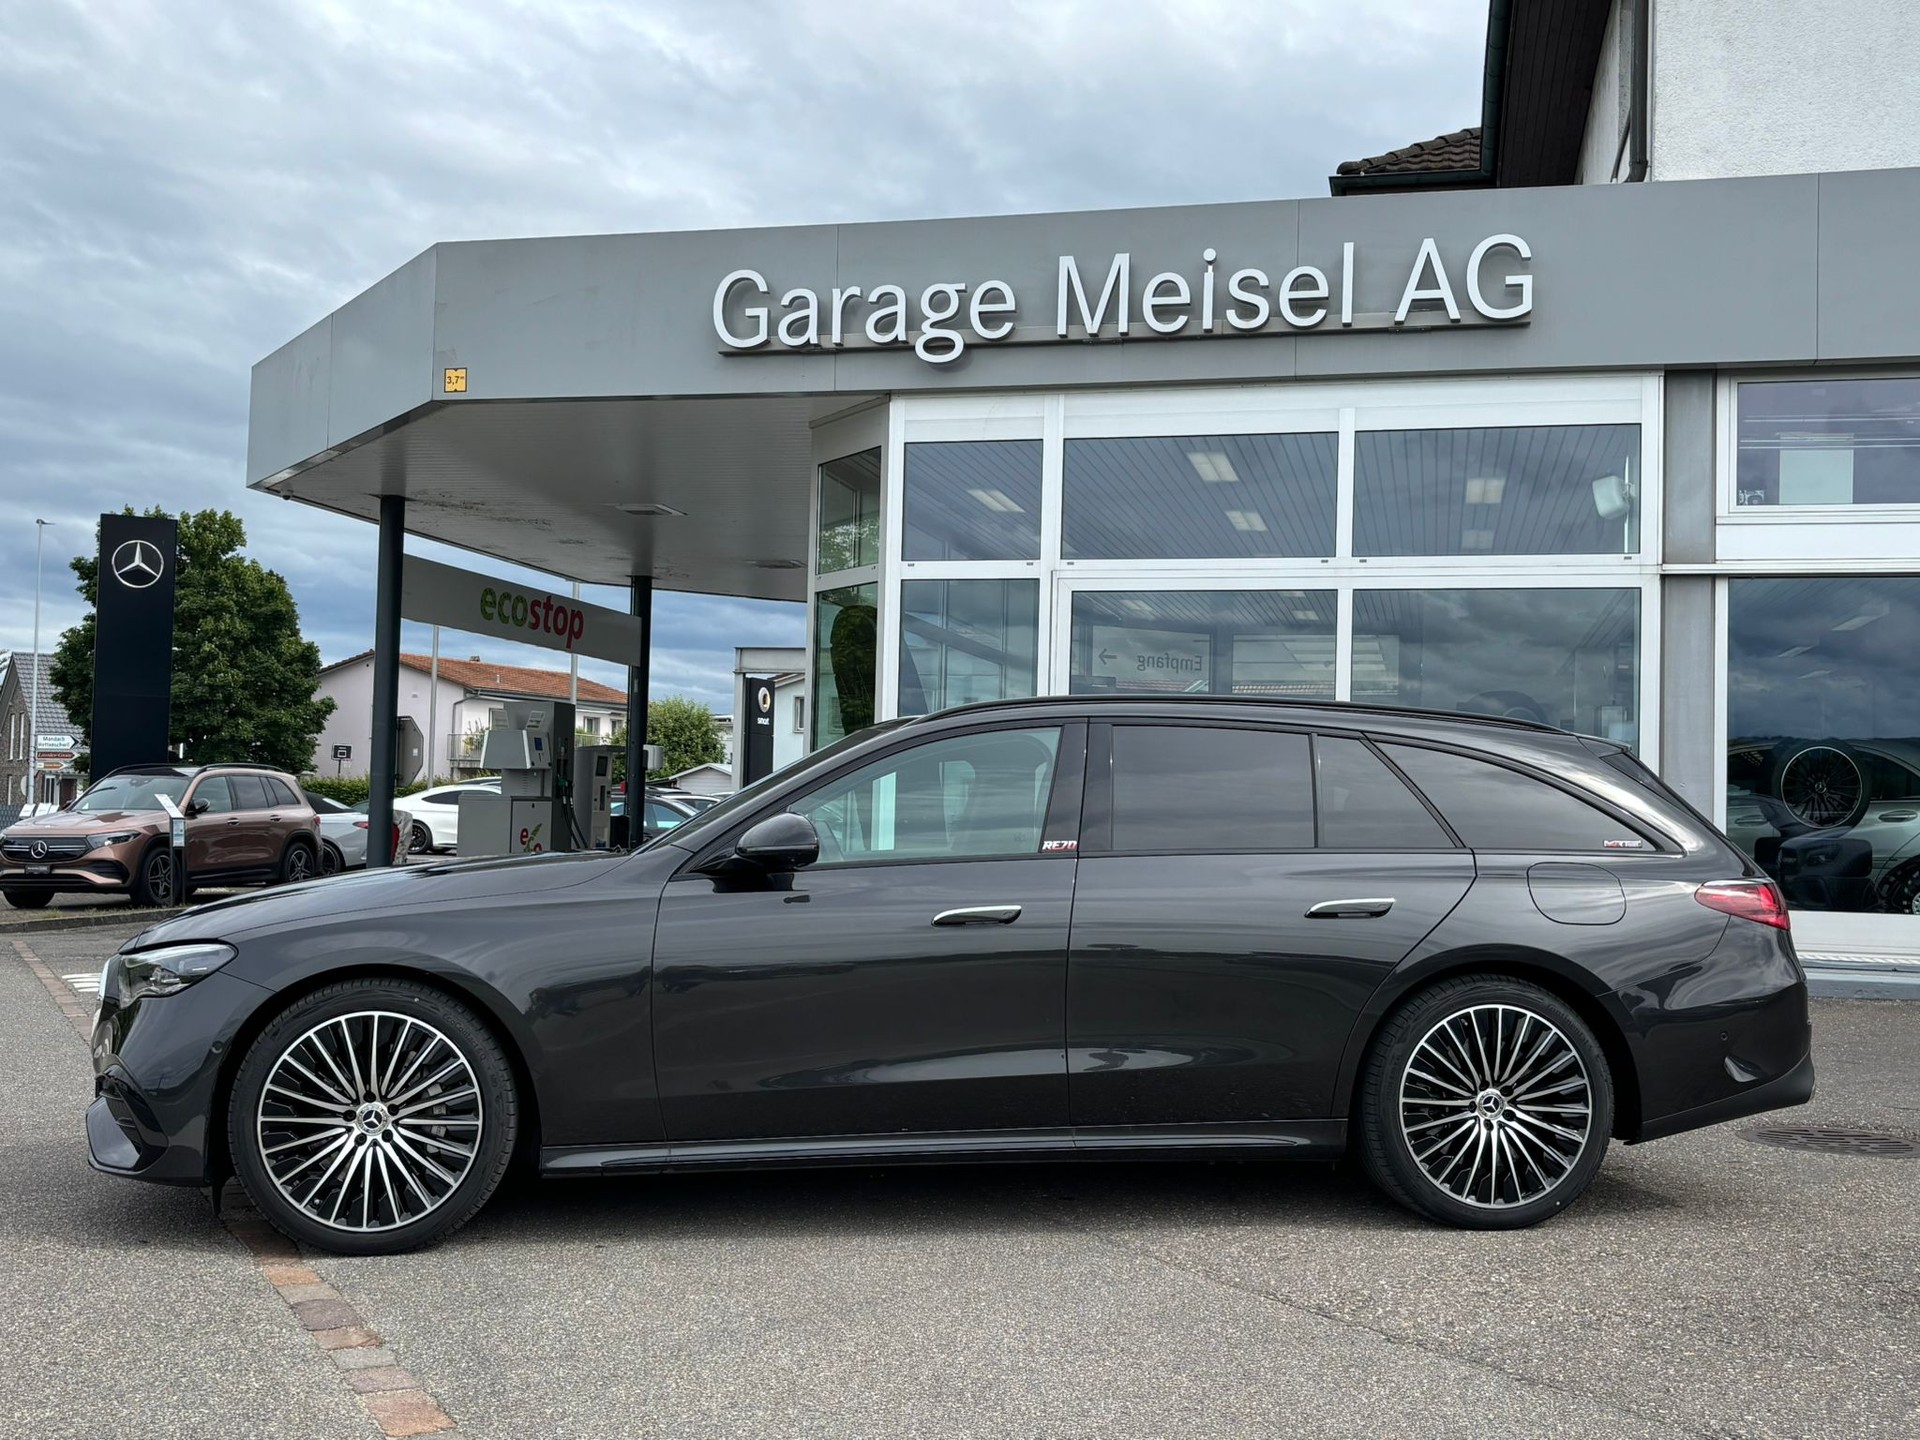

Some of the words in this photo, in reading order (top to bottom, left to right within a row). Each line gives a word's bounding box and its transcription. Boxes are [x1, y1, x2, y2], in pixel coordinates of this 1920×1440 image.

[711, 268, 1017, 366] Garage
[1056, 248, 1355, 339] Meisel
[1395, 233, 1535, 326] AG
[480, 587, 584, 649] ecostop
